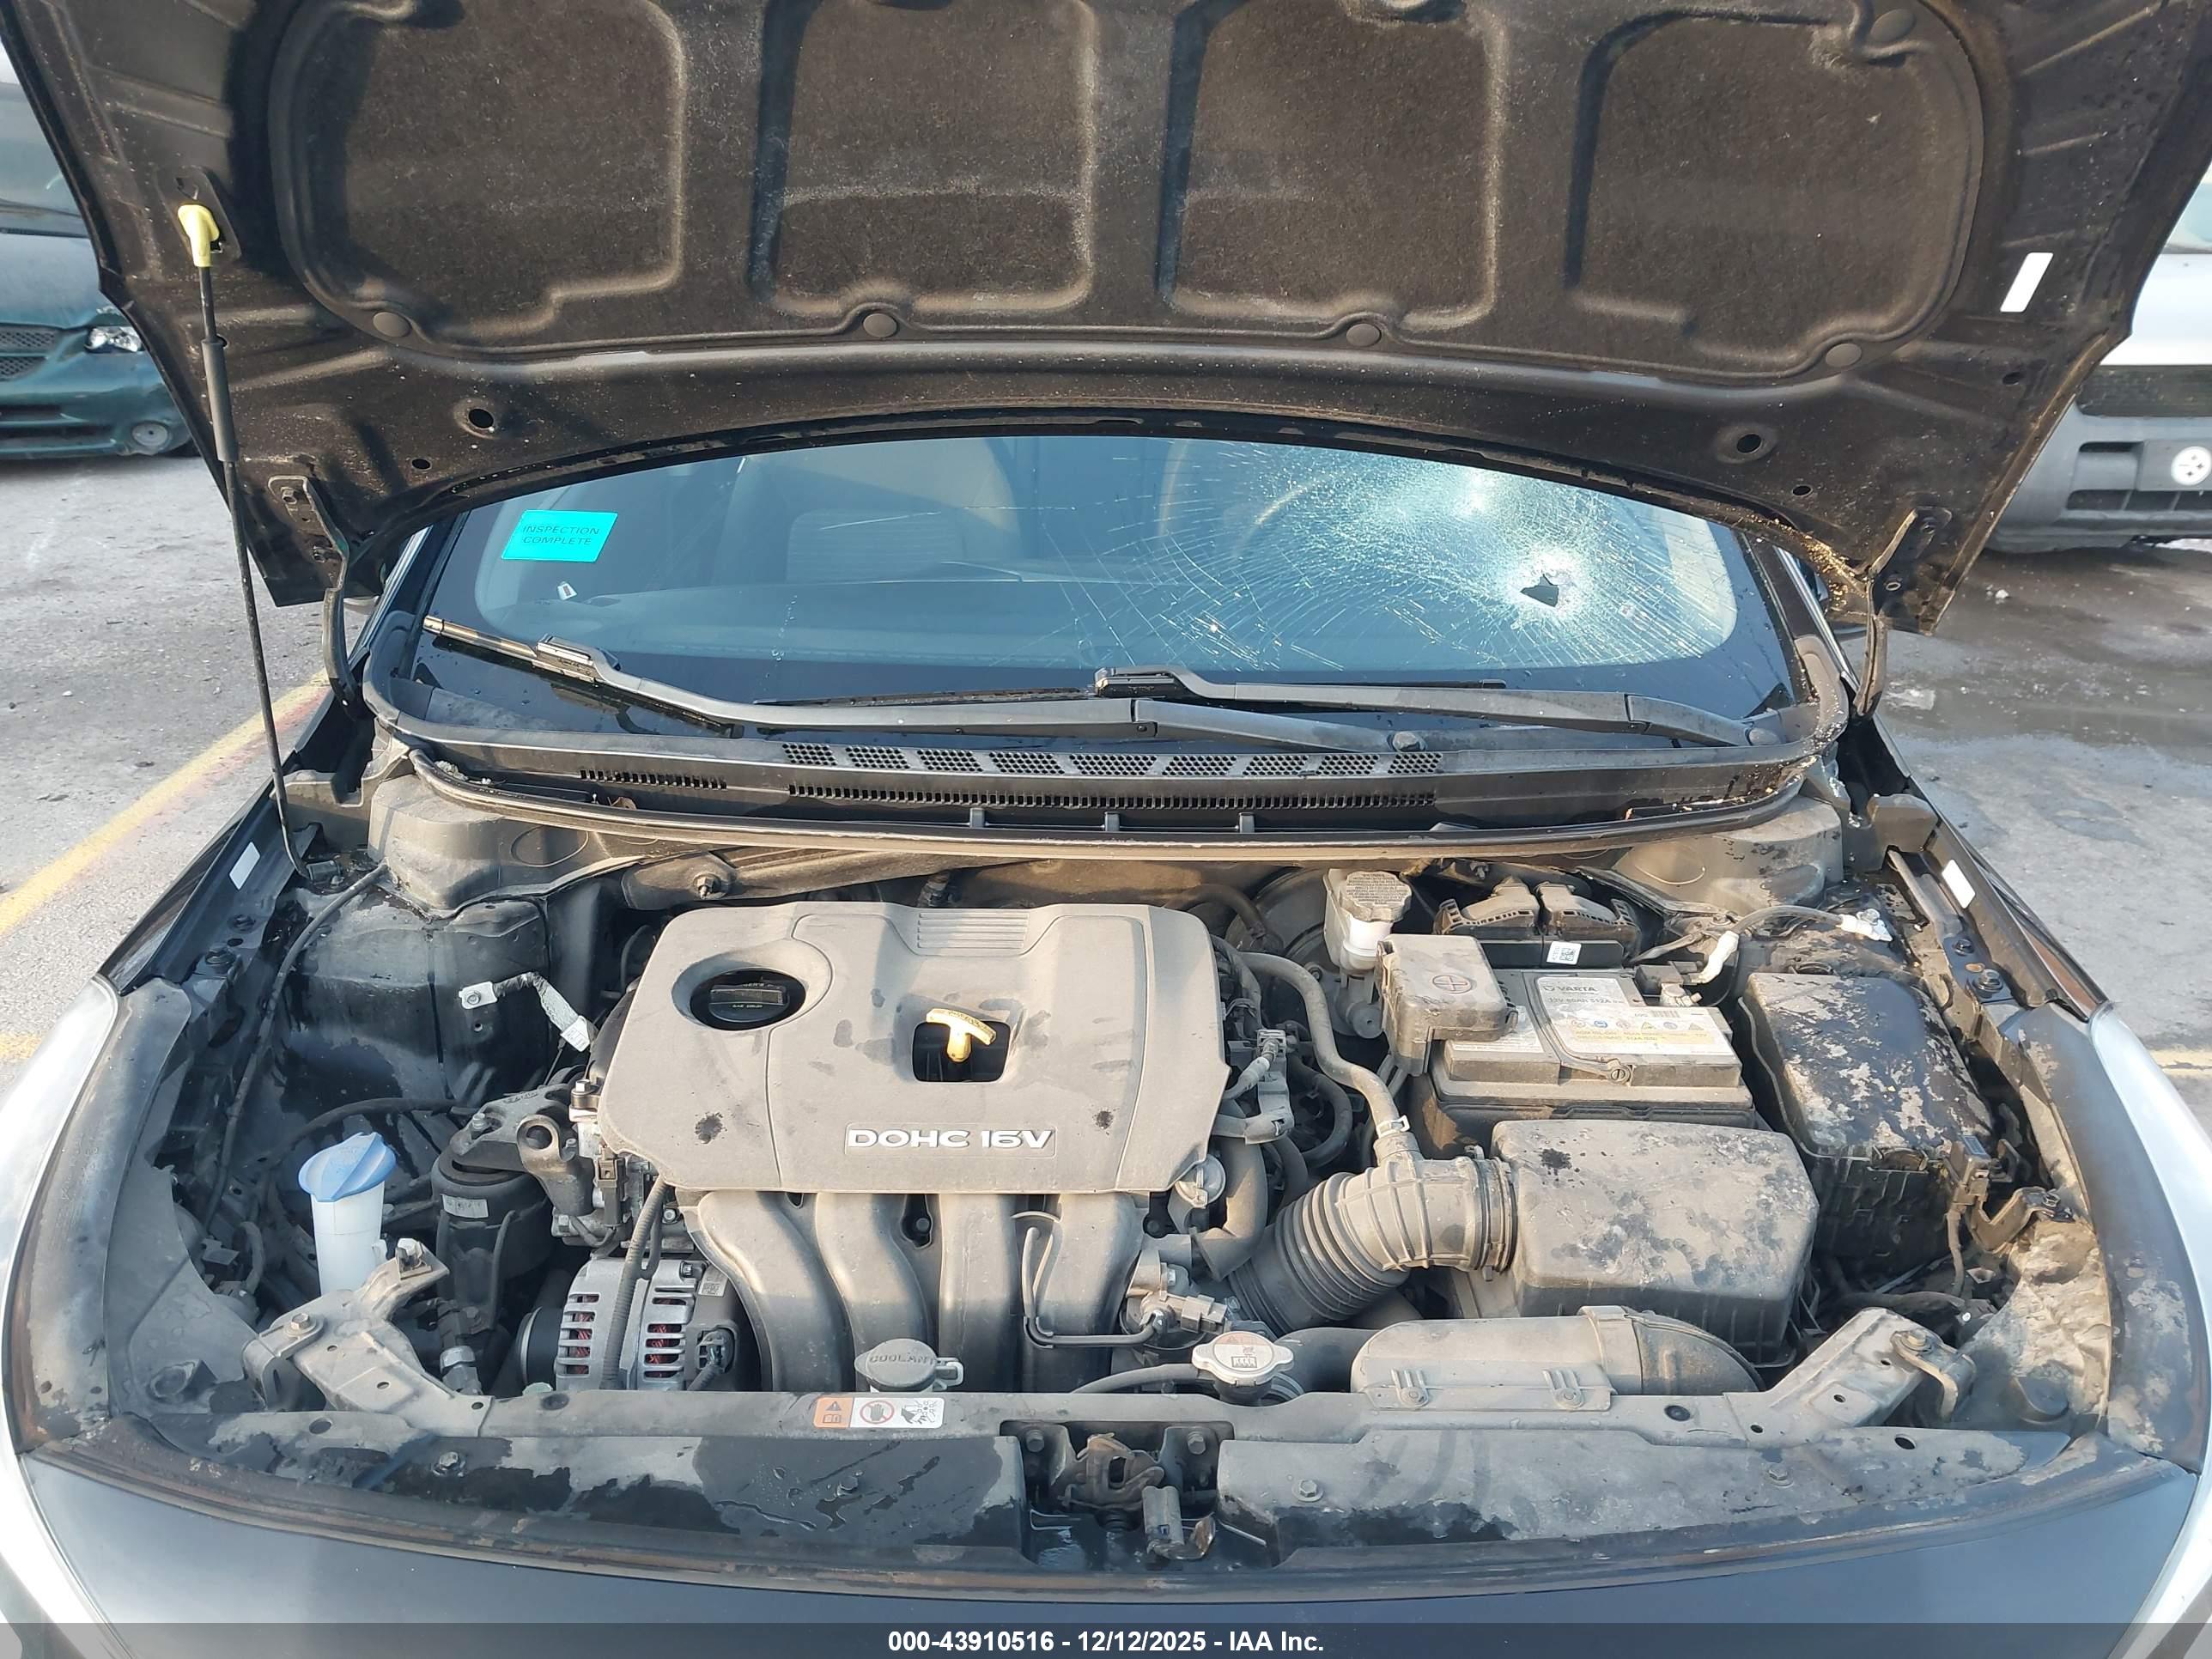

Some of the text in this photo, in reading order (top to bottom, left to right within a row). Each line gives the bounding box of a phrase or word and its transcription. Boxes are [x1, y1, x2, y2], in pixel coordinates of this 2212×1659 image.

[523, 526, 600, 535] INSPECTION
[523, 536, 592, 545] COMPLETE
[848, 1129, 1054, 1149] DOHC 16V
[870, 1354, 934, 1365] COOLANT
